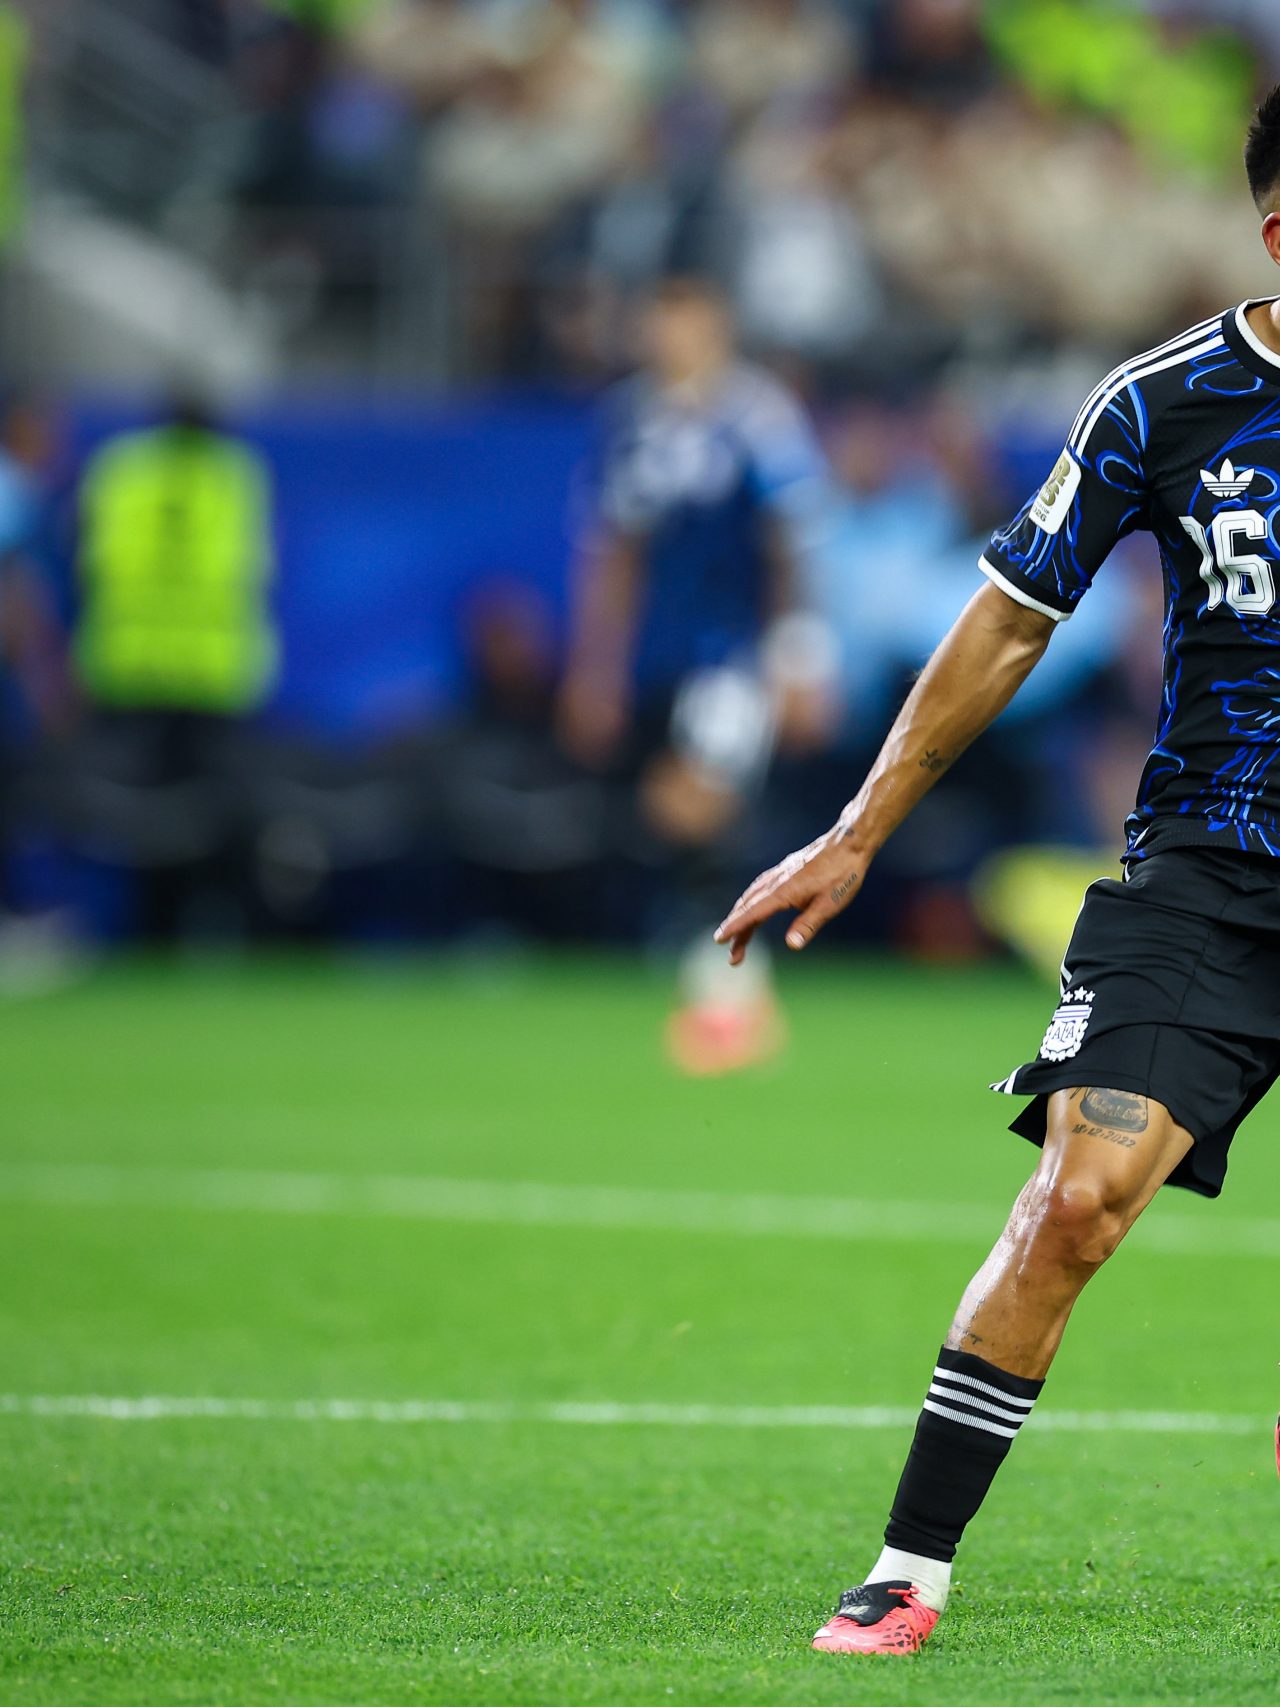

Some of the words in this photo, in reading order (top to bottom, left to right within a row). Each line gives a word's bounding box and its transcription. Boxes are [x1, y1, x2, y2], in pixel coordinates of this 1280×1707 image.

[1033, 506, 1047, 521] 026
[1178, 509, 1277, 615] 16
[1051, 1020, 1077, 1043] AFA
